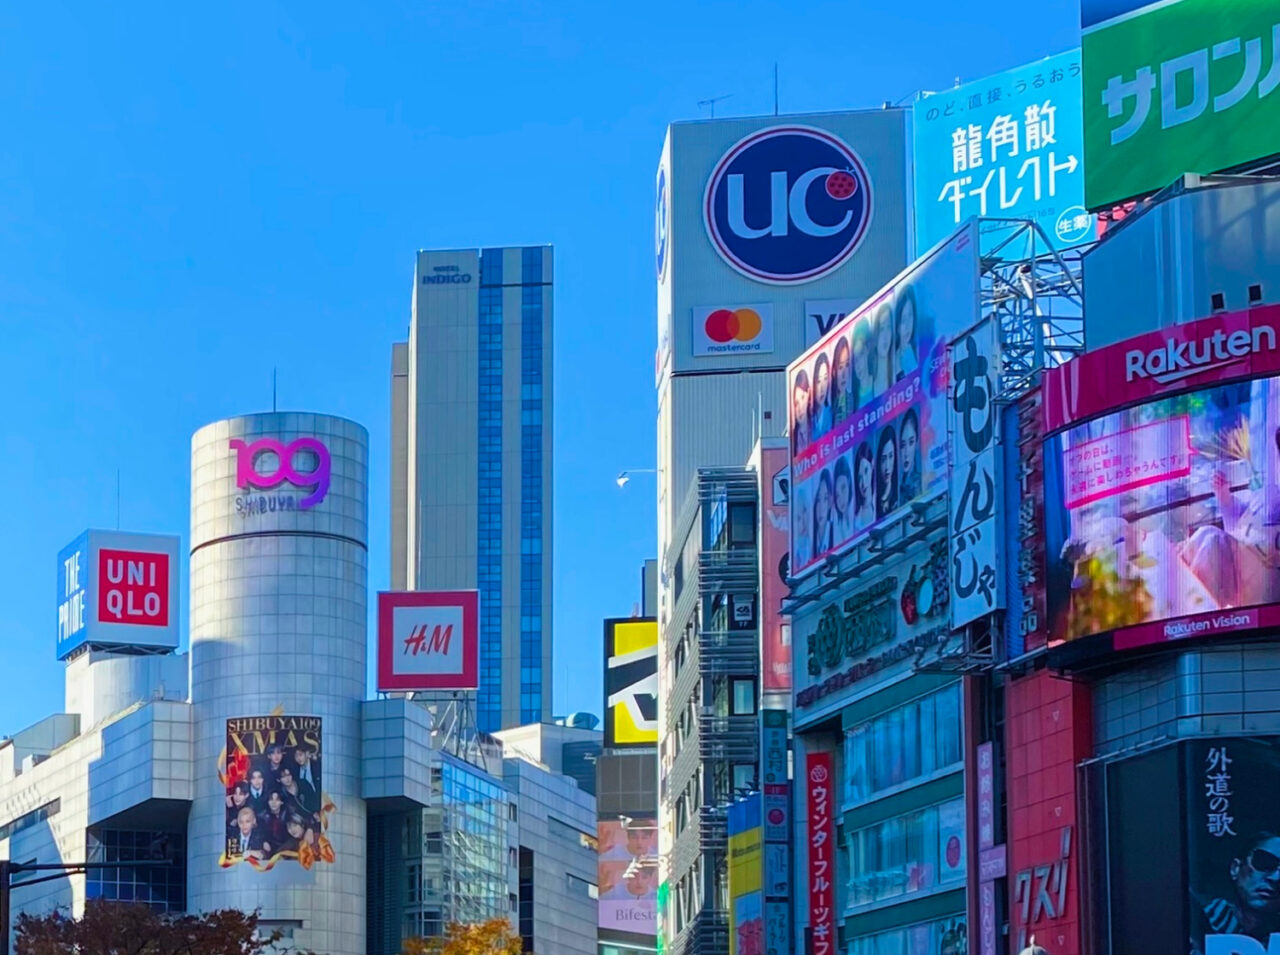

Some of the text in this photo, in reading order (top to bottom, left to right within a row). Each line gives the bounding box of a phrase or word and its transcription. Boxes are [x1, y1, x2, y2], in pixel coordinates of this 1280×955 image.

[1102, 26, 1280, 145] サロン
[951, 99, 1057, 174] 龍角散
[726, 165, 853, 241] UC
[937, 152, 1078, 223] ダイレクト
[422, 273, 472, 285] INDIGO
[707, 342, 761, 352] mastercard
[1125, 326, 1277, 383] Rakuten
[794, 452, 817, 477] Who
[833, 424, 855, 451] last
[857, 376, 920, 431] standing?
[229, 437, 331, 510] 109
[953, 334, 996, 609] もんじゃ
[106, 558, 157, 587] UNI
[106, 588, 161, 619] QLO
[1164, 613, 1250, 637] Rakuten Vision
[404, 623, 453, 656] H&M
[228, 717, 320, 733] SHIBUYA109
[228, 729, 320, 756] XMAS
[1205, 747, 1237, 838] 外道の歌
